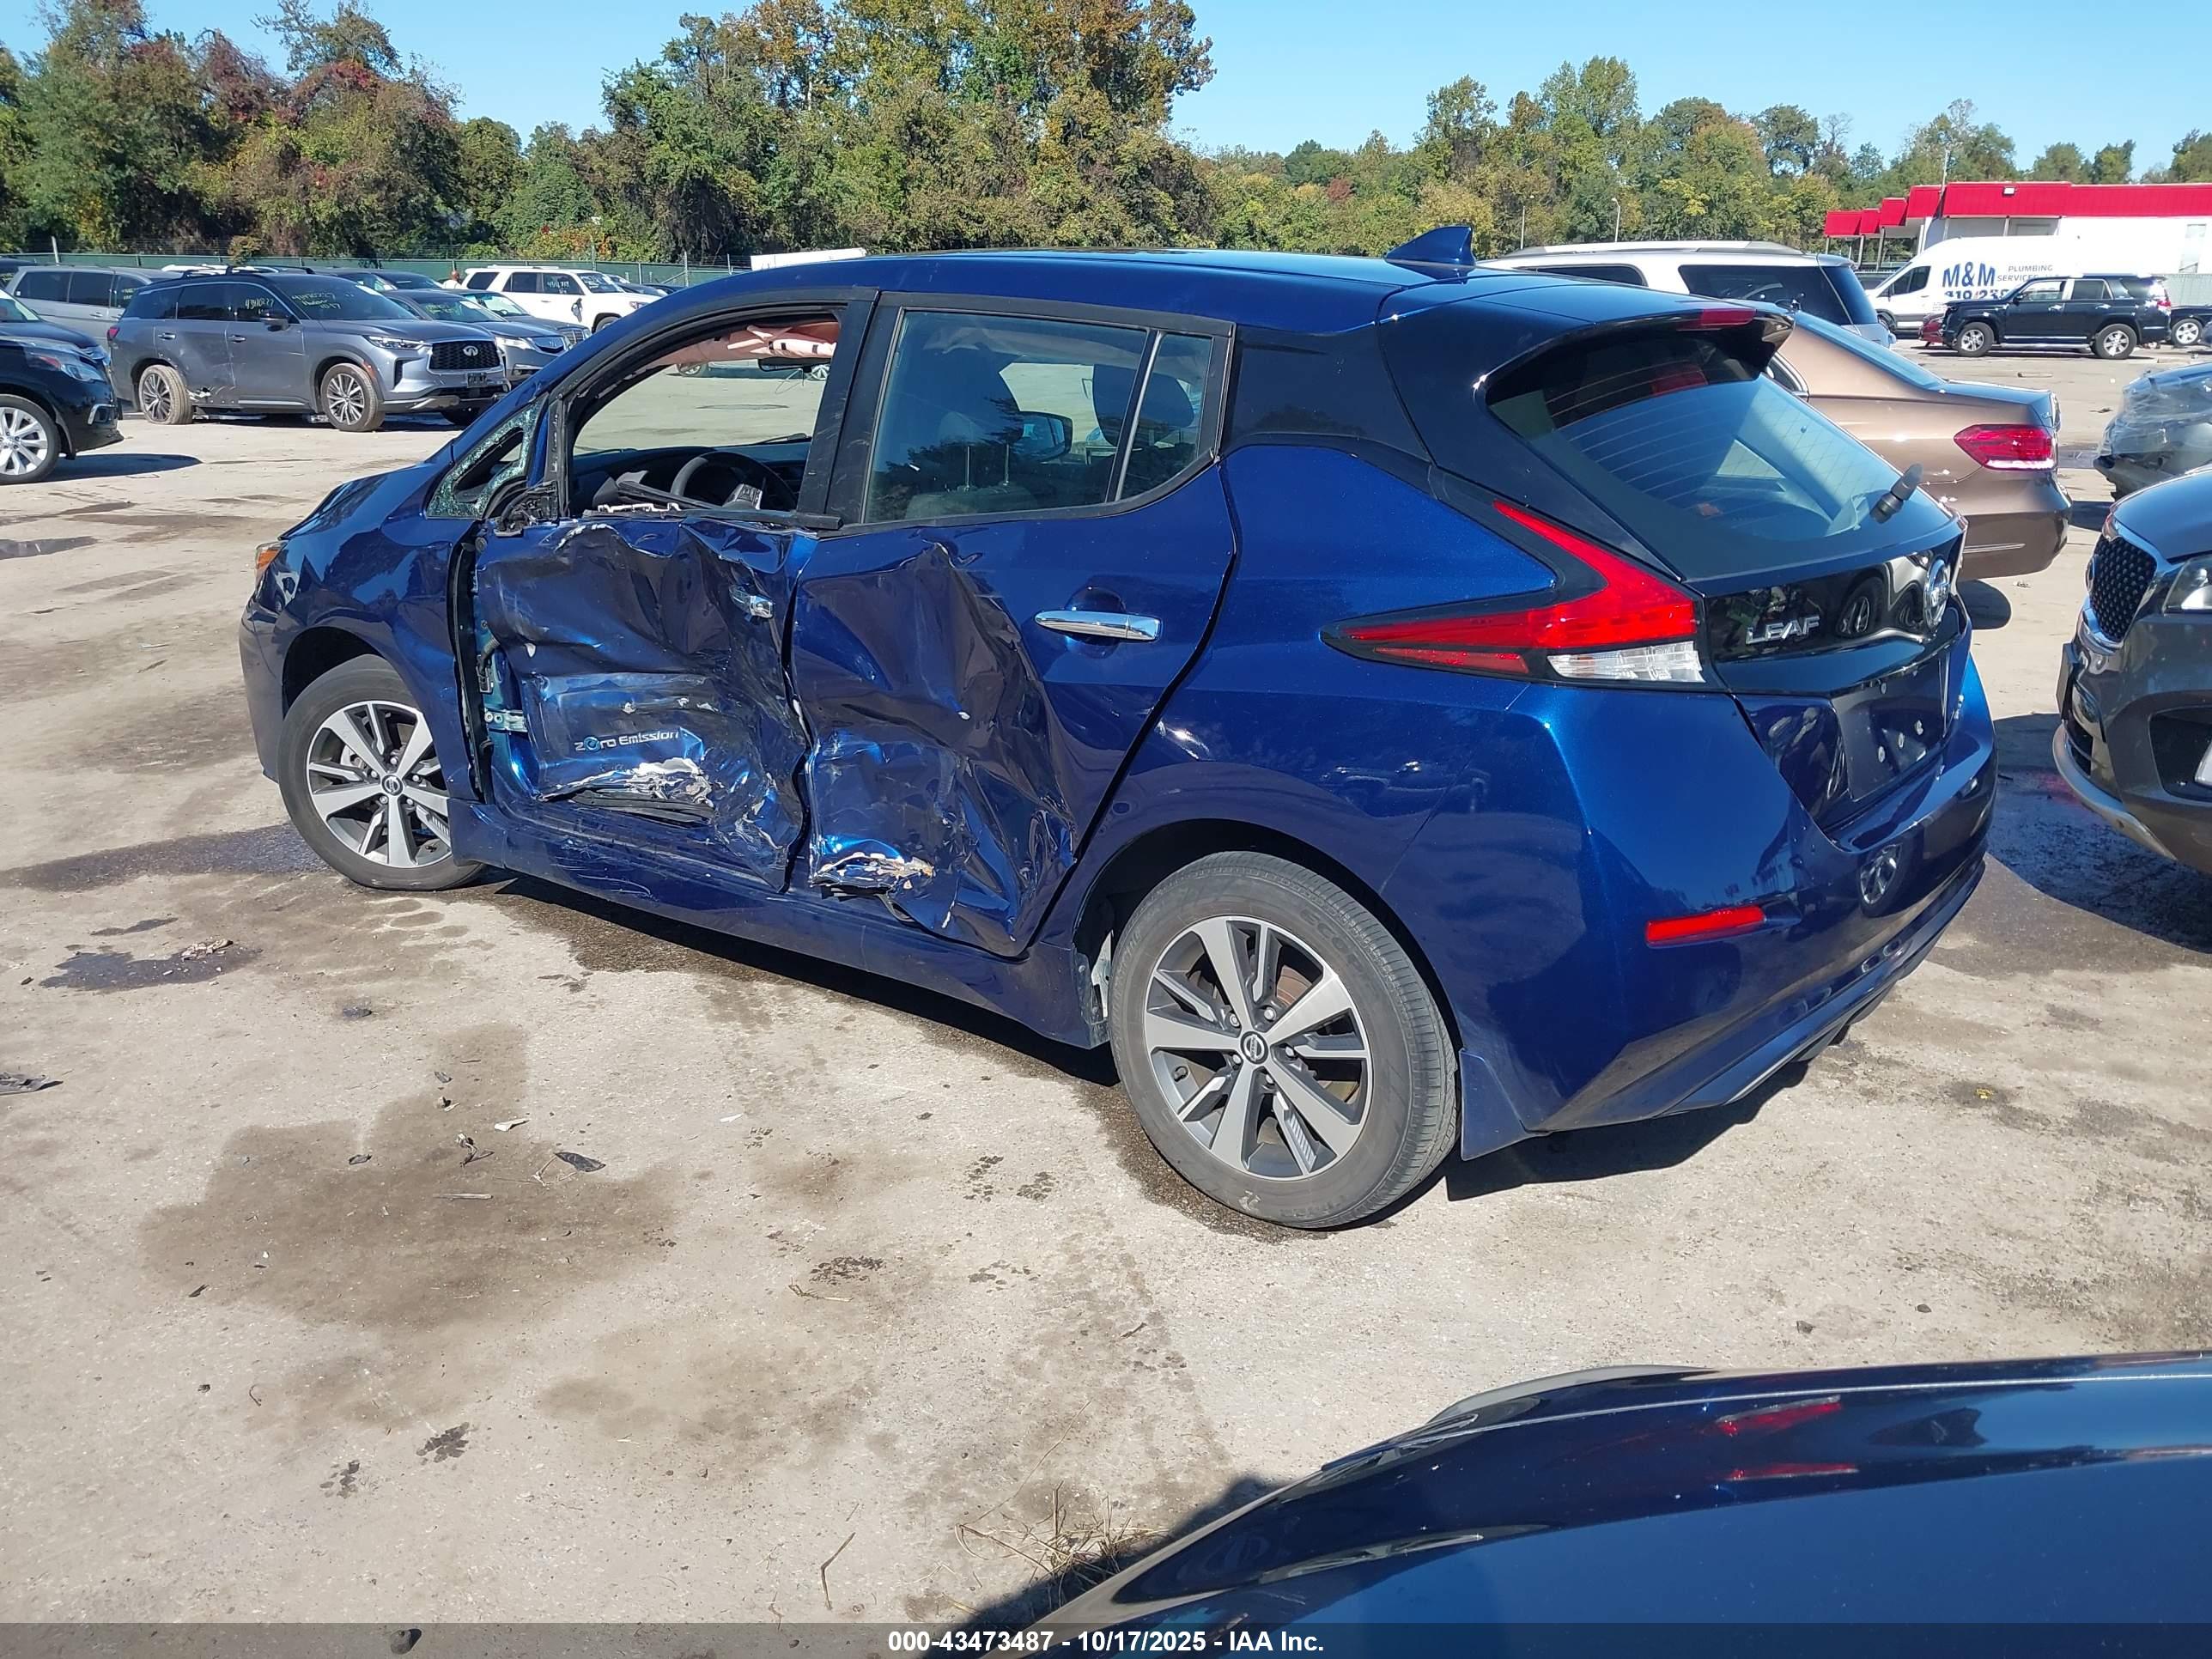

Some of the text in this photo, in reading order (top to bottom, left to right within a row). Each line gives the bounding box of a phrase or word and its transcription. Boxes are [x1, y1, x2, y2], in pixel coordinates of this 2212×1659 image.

[1942, 261, 1996, 288] M&M
[2008, 264, 2053, 273] PLUMBING
[1746, 616, 1820, 644] LEAF
[618, 731, 678, 745] Emission
